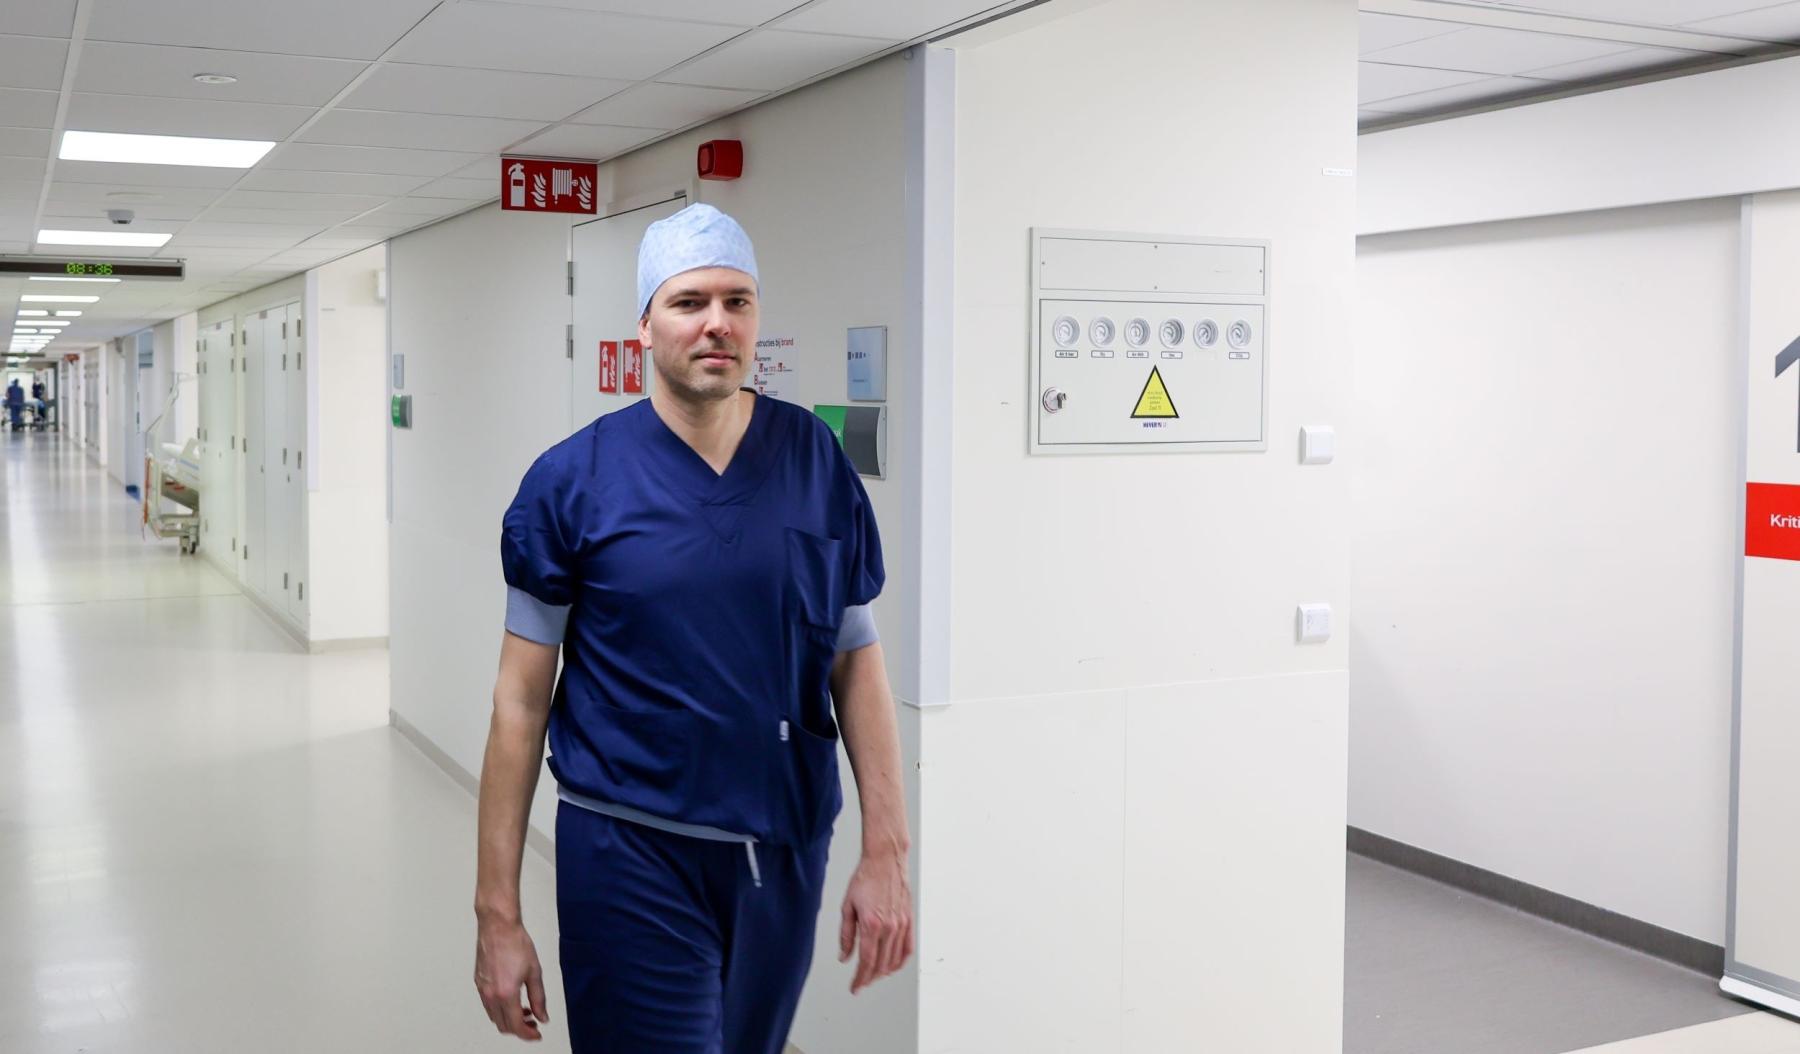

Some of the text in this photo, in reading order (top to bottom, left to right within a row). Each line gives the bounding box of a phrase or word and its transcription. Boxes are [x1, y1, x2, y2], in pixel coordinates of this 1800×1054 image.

[66, 262, 113, 275] 08:36
[1775, 335, 1800, 453] 1
[1770, 513, 1800, 529] Kriti
